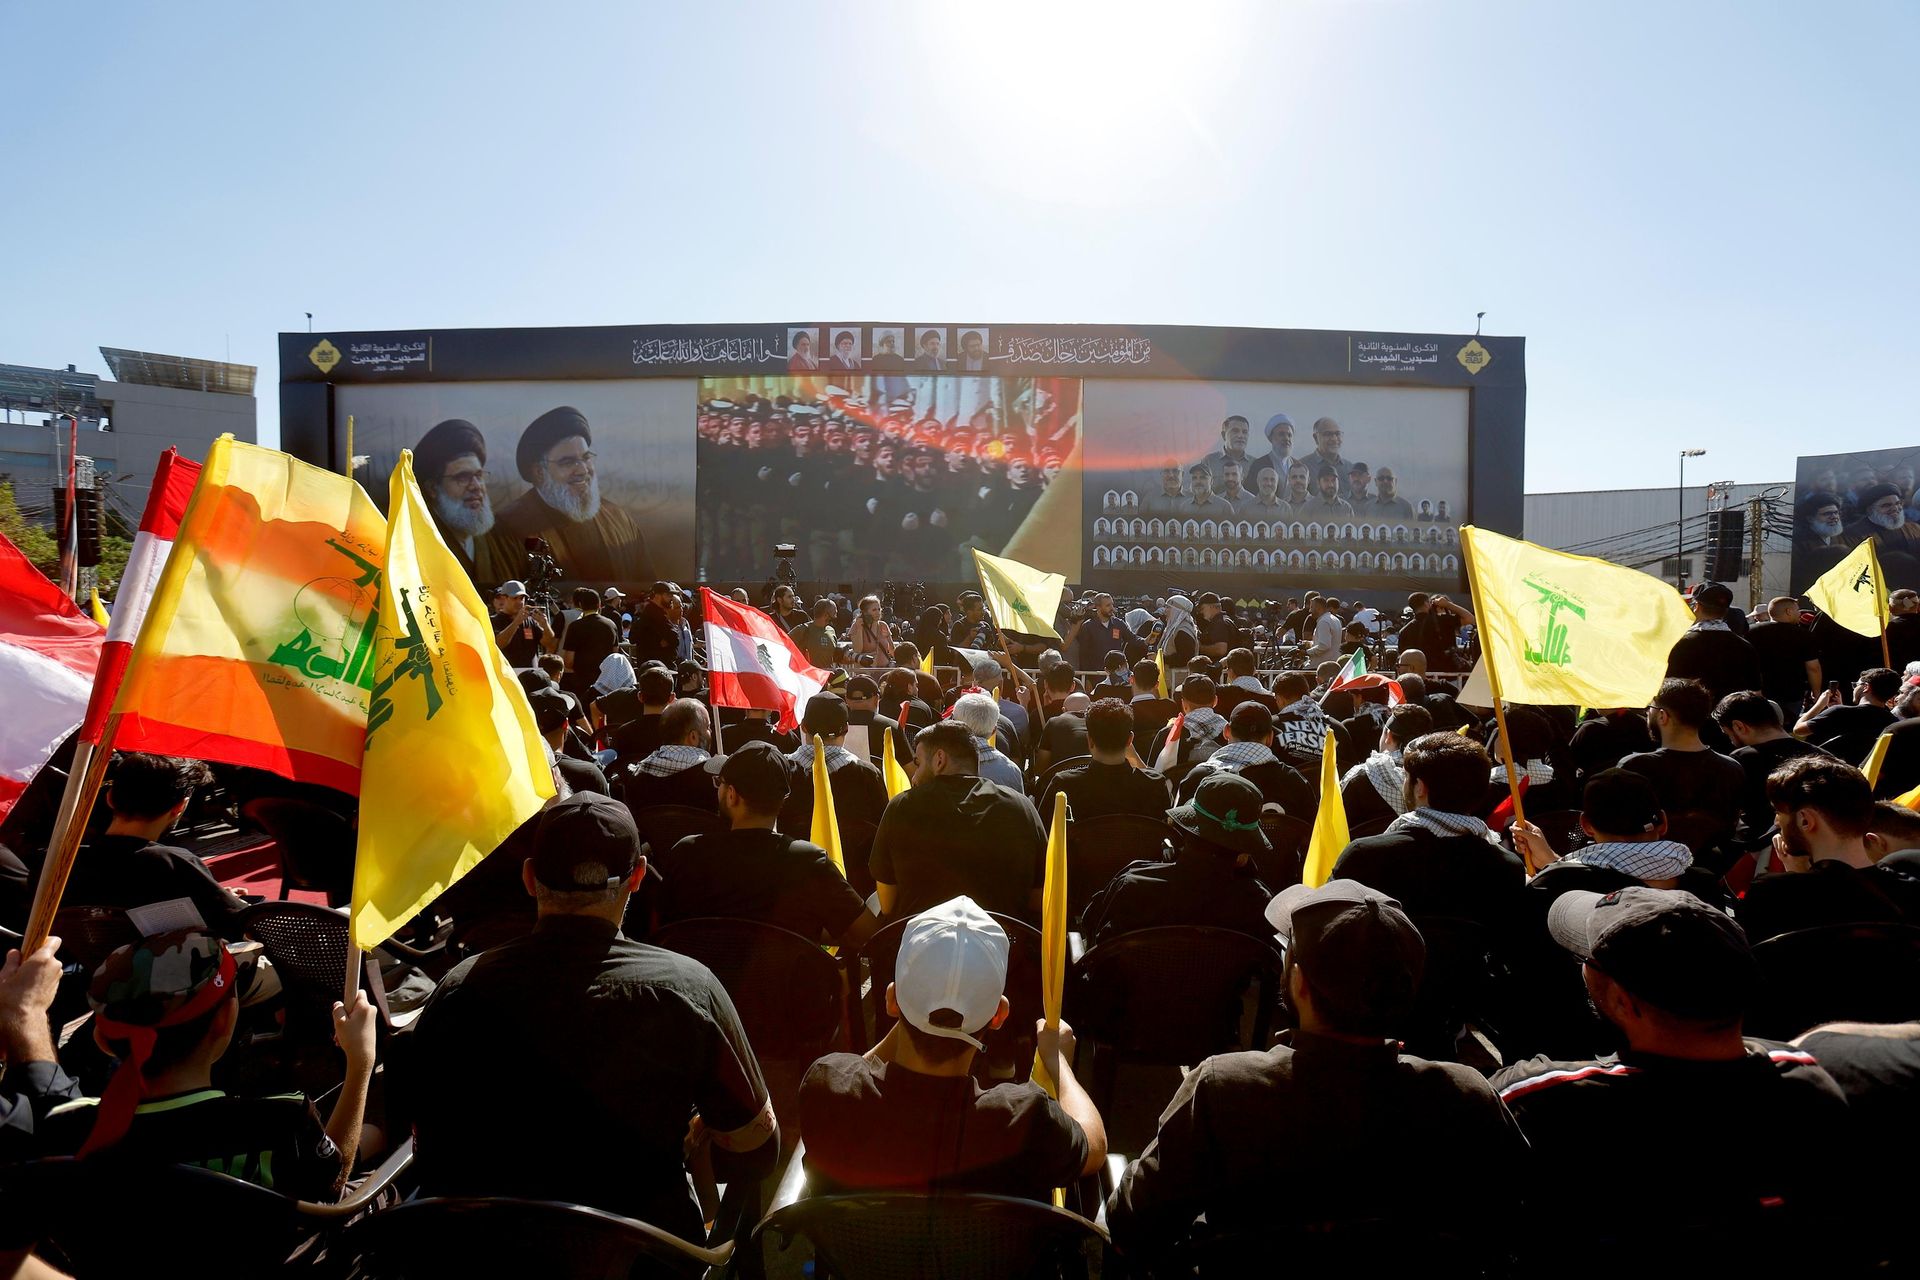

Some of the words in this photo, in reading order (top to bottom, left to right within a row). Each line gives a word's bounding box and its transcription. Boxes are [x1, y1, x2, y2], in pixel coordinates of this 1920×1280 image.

[1358, 341, 1380, 352] الثانية
[1381, 341, 1412, 353] السنوية
[1412, 343, 1438, 354] الذكرى
[1358, 353, 1400, 363] الشهيدين
[1400, 354, 1438, 364] للسيدين
[1283, 720, 1327, 736] NEW
[1276, 731, 1324, 750] JERS
